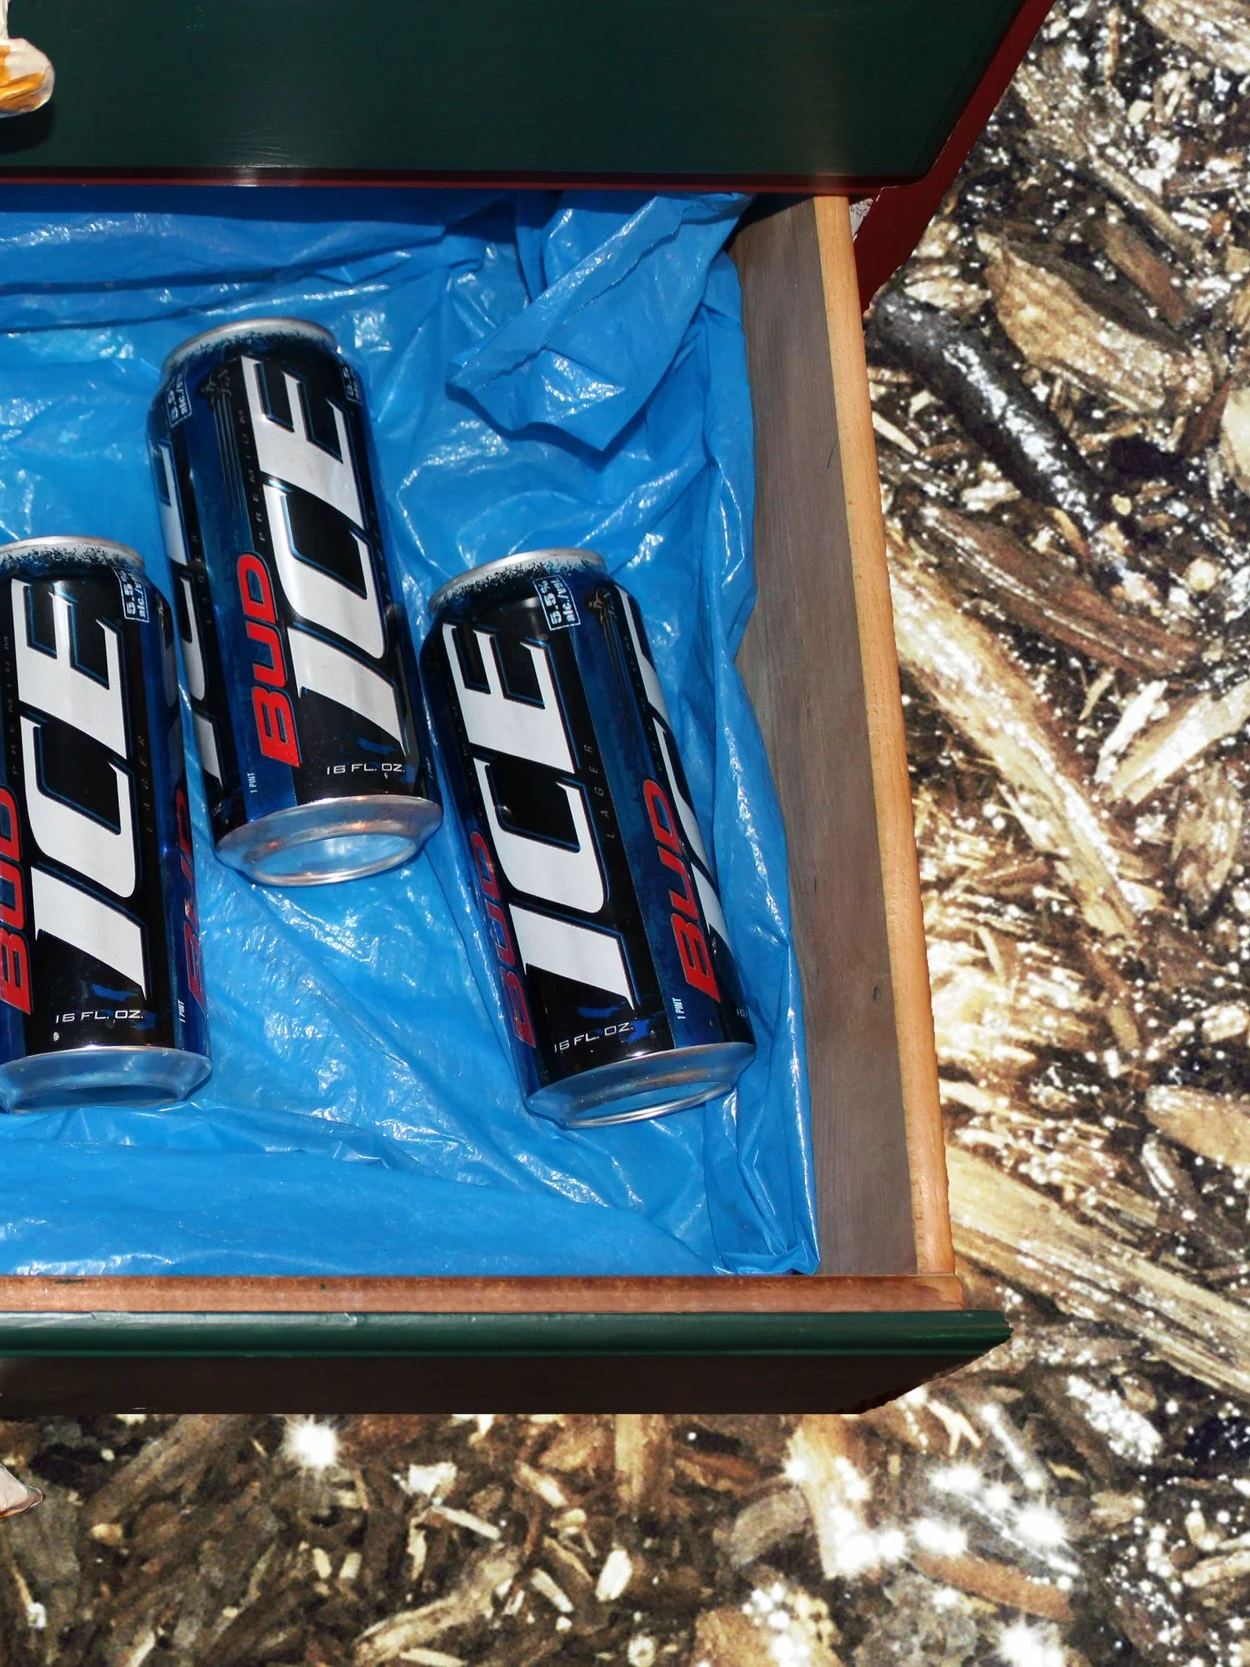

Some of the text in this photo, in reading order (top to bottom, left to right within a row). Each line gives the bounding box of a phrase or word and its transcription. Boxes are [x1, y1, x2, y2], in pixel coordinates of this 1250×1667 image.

[241, 355, 406, 757] ICE
[538, 580, 563, 625] 5.5%
[238, 553, 301, 768] BUD
[11, 577, 146, 1001] ICE
[247, 772, 257, 788] PINT
[327, 763, 405, 775] 16 FL. OZ.
[583, 744, 616, 839] LAGER
[442, 623, 637, 1011] ICE
[644, 779, 721, 1003] BUD
[55, 1010, 143, 1024] 16 FL. OZ.
[177, 999, 186, 1018] PINT
[672, 997, 685, 1015] PINT
[554, 1022, 634, 1053] 16 FL. OZ.
